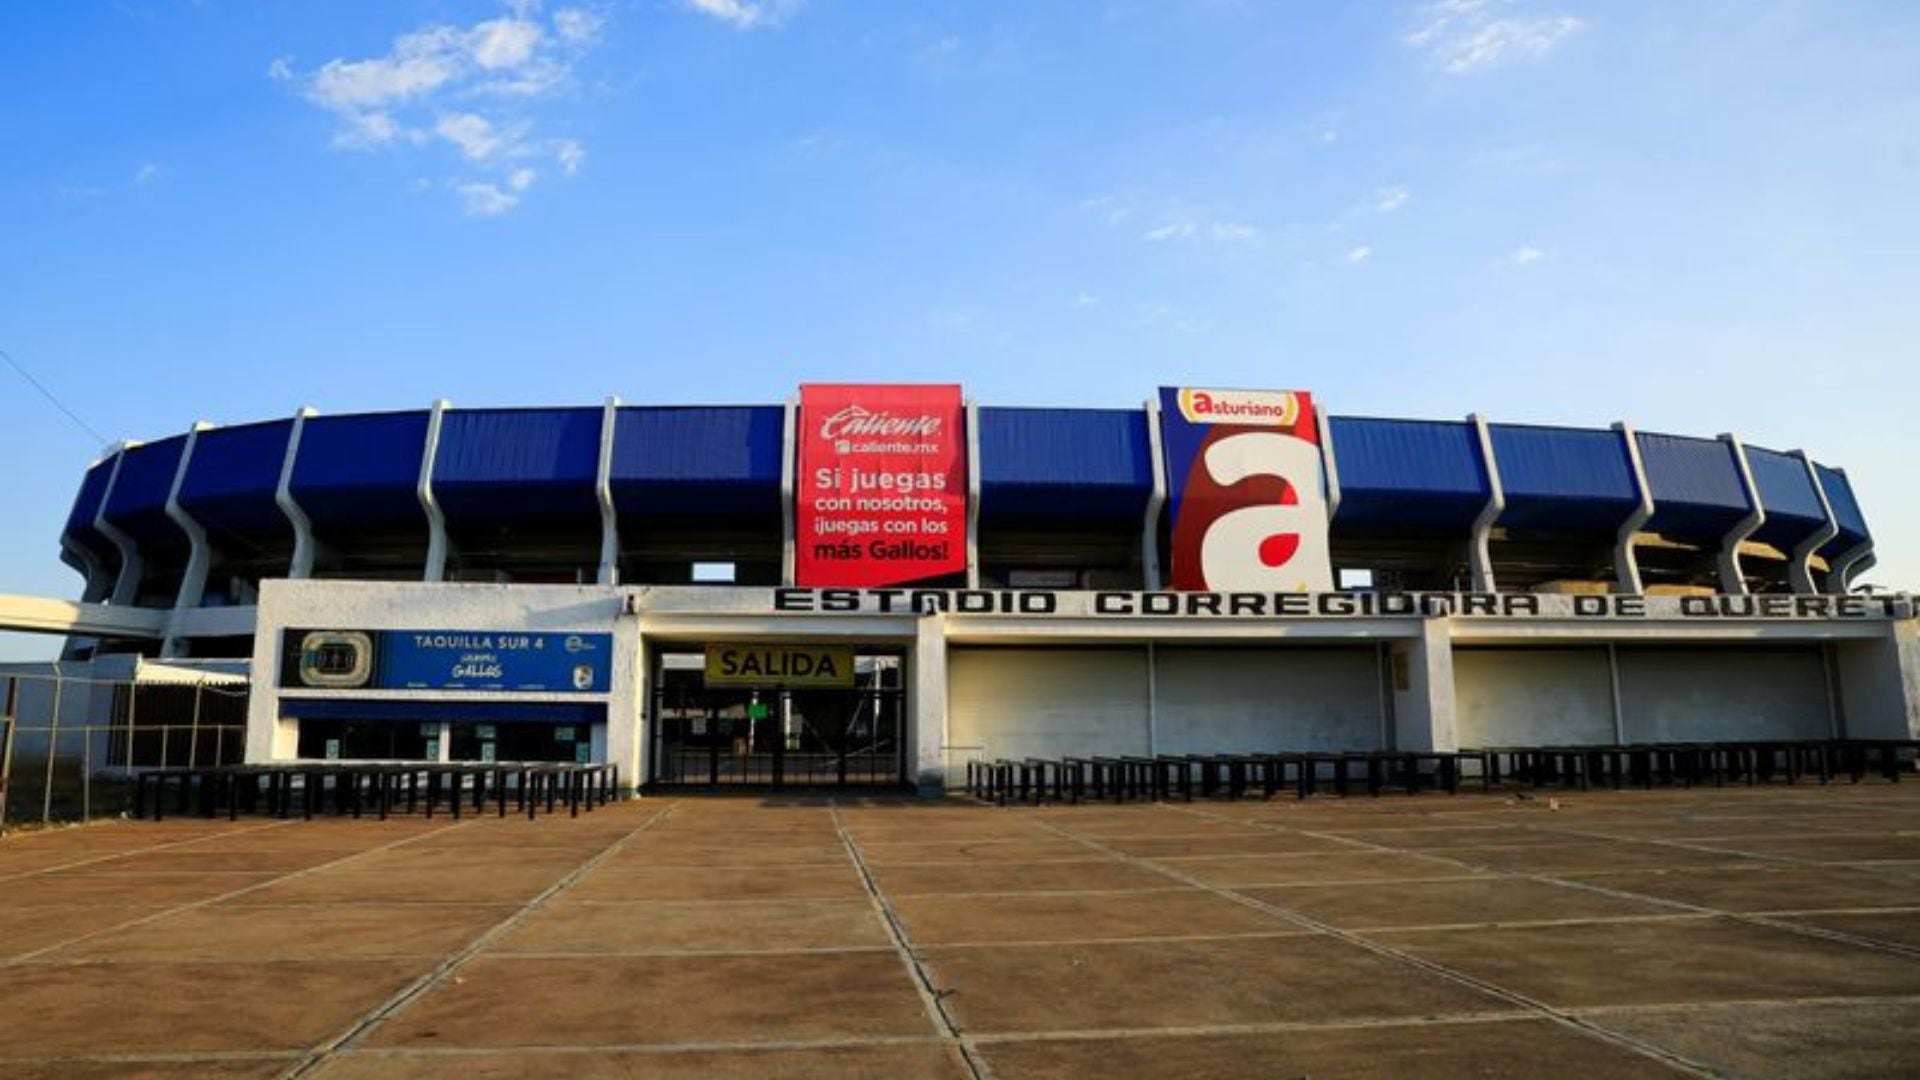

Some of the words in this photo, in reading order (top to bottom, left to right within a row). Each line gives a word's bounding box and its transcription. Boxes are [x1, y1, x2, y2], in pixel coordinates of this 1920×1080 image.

[1192, 392, 1284, 417] asturiano
[820, 404, 942, 441] Caliente
[815, 468, 841, 489] Si
[851, 469, 946, 493] juegas
[815, 498, 851, 511] con
[856, 496, 948, 514] nosotros,
[883, 520, 917, 533] con
[921, 517, 948, 534] los
[814, 540, 863, 560] más
[869, 540, 949, 561] Gallos!
[774, 588, 1056, 614] ESTADIO
[1095, 592, 1540, 616] CORREGIDORA
[1574, 595, 1646, 616] DE
[414, 635, 493, 649] TAQUILLA
[498, 636, 530, 649] SUR
[534, 637, 544, 649] 4
[721, 650, 838, 678] SALIDA
